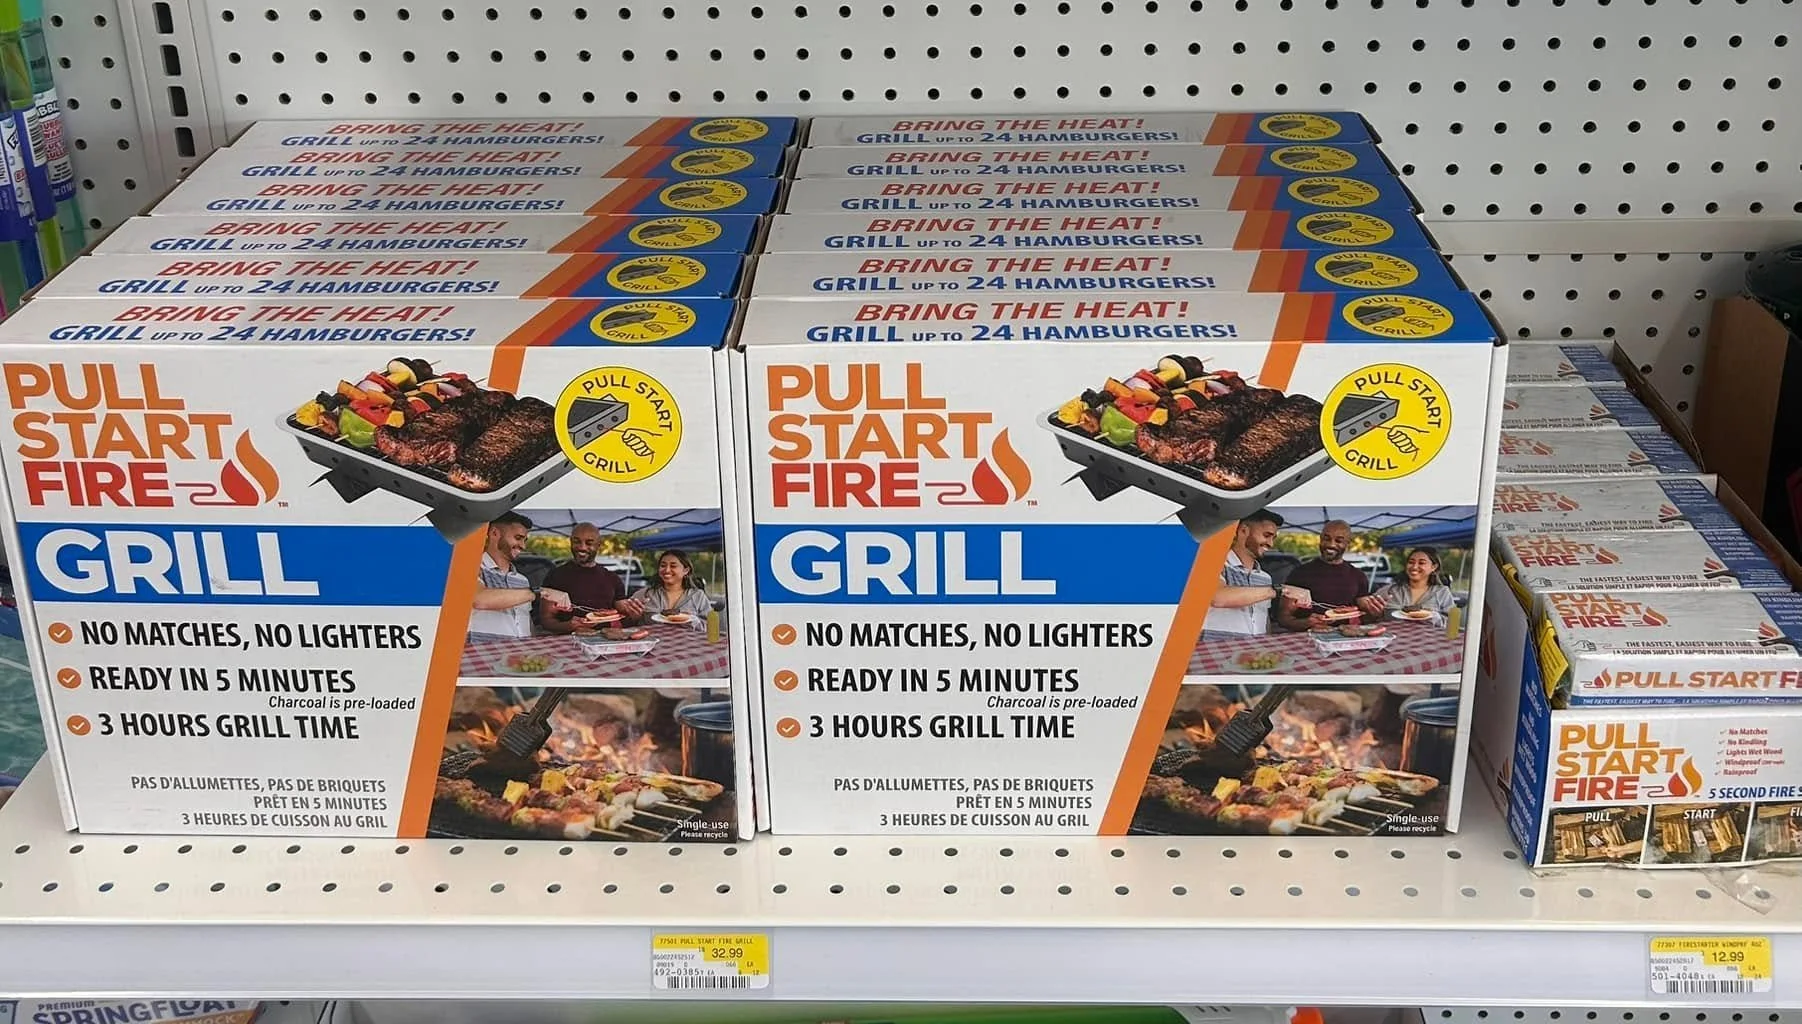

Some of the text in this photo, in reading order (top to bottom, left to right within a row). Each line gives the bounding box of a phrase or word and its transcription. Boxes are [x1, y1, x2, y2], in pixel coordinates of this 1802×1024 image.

[113, 305, 455, 322] BRING THE HEAT!
[49, 326, 477, 342] GRILL UP TO 24 HAMBURGERS!
[2, 363, 185, 410] PULL
[766, 362, 947, 412] PULL
[582, 374, 672, 432] PULL START
[1354, 371, 1441, 428] PULL START
[12, 412, 233, 460] START
[768, 412, 993, 460] START
[584, 452, 636, 473] GRILL
[1345, 449, 1398, 470] GRILL
[22, 460, 174, 508] FIRE
[771, 462, 921, 508] FIRE
[35, 528, 320, 596] GRILL
[770, 530, 1057, 595] GRILL
[80, 621, 422, 652] NO MATCHES, NO LIGHTERS
[806, 622, 1153, 652] NO MATCHES, NO LIGHTERS
[89, 666, 356, 693] READY IN 5 MINUTES
[808, 668, 1079, 692] READY IN 5 MINUTES
[1615, 671, 1777, 688] PULL START
[269, 695, 416, 712] Charcoal is pre-loaded
[987, 695, 1137, 711] Charcoal is pre-loaded
[100, 712, 359, 740] 3 HOURS GRILL TIME
[809, 715, 1075, 738] 3 HOURS GRILL TIME
[1559, 723, 1660, 750] PULL
[1739, 738, 1767, 746] Kindling
[1555, 748, 1685, 776] START
[1726, 749, 1746, 757] Lights
[1723, 768, 1757, 776] Rainproof
[1725, 759, 1762, 767] Windproof
[131, 776, 386, 796] PAS D'ALLUMETTES, PAS DE BRIQUETS
[834, 778, 1094, 794] PAS D'ALLUMETTES, PAS DE BRIQUETS
[1553, 776, 1640, 802] FIRE
[1708, 788, 1716, 799] 5
[1719, 786, 1765, 799] SECOND
[1768, 786, 1795, 798] FIRE
[254, 793, 387, 811] PRÊT EN 5 MINUTES
[956, 794, 1092, 809] PRÊT EN 5 MINUTES
[182, 813, 388, 828] 3 HEURES DE CUISSON AU GRIL
[880, 813, 1089, 827] 3 HEURES DE CUISSON AU GRIL
[1386, 814, 1439, 824] Single-use
[1584, 812, 1612, 822] PULL
[1684, 809, 1717, 819] START
[677, 819, 729, 830] Single-use
[704, 831, 728, 839] recycle
[712, 948, 743, 958] 32.99
[1712, 952, 1744, 962] 12.99
[38, 1000, 95, 1011] PREMIUM
